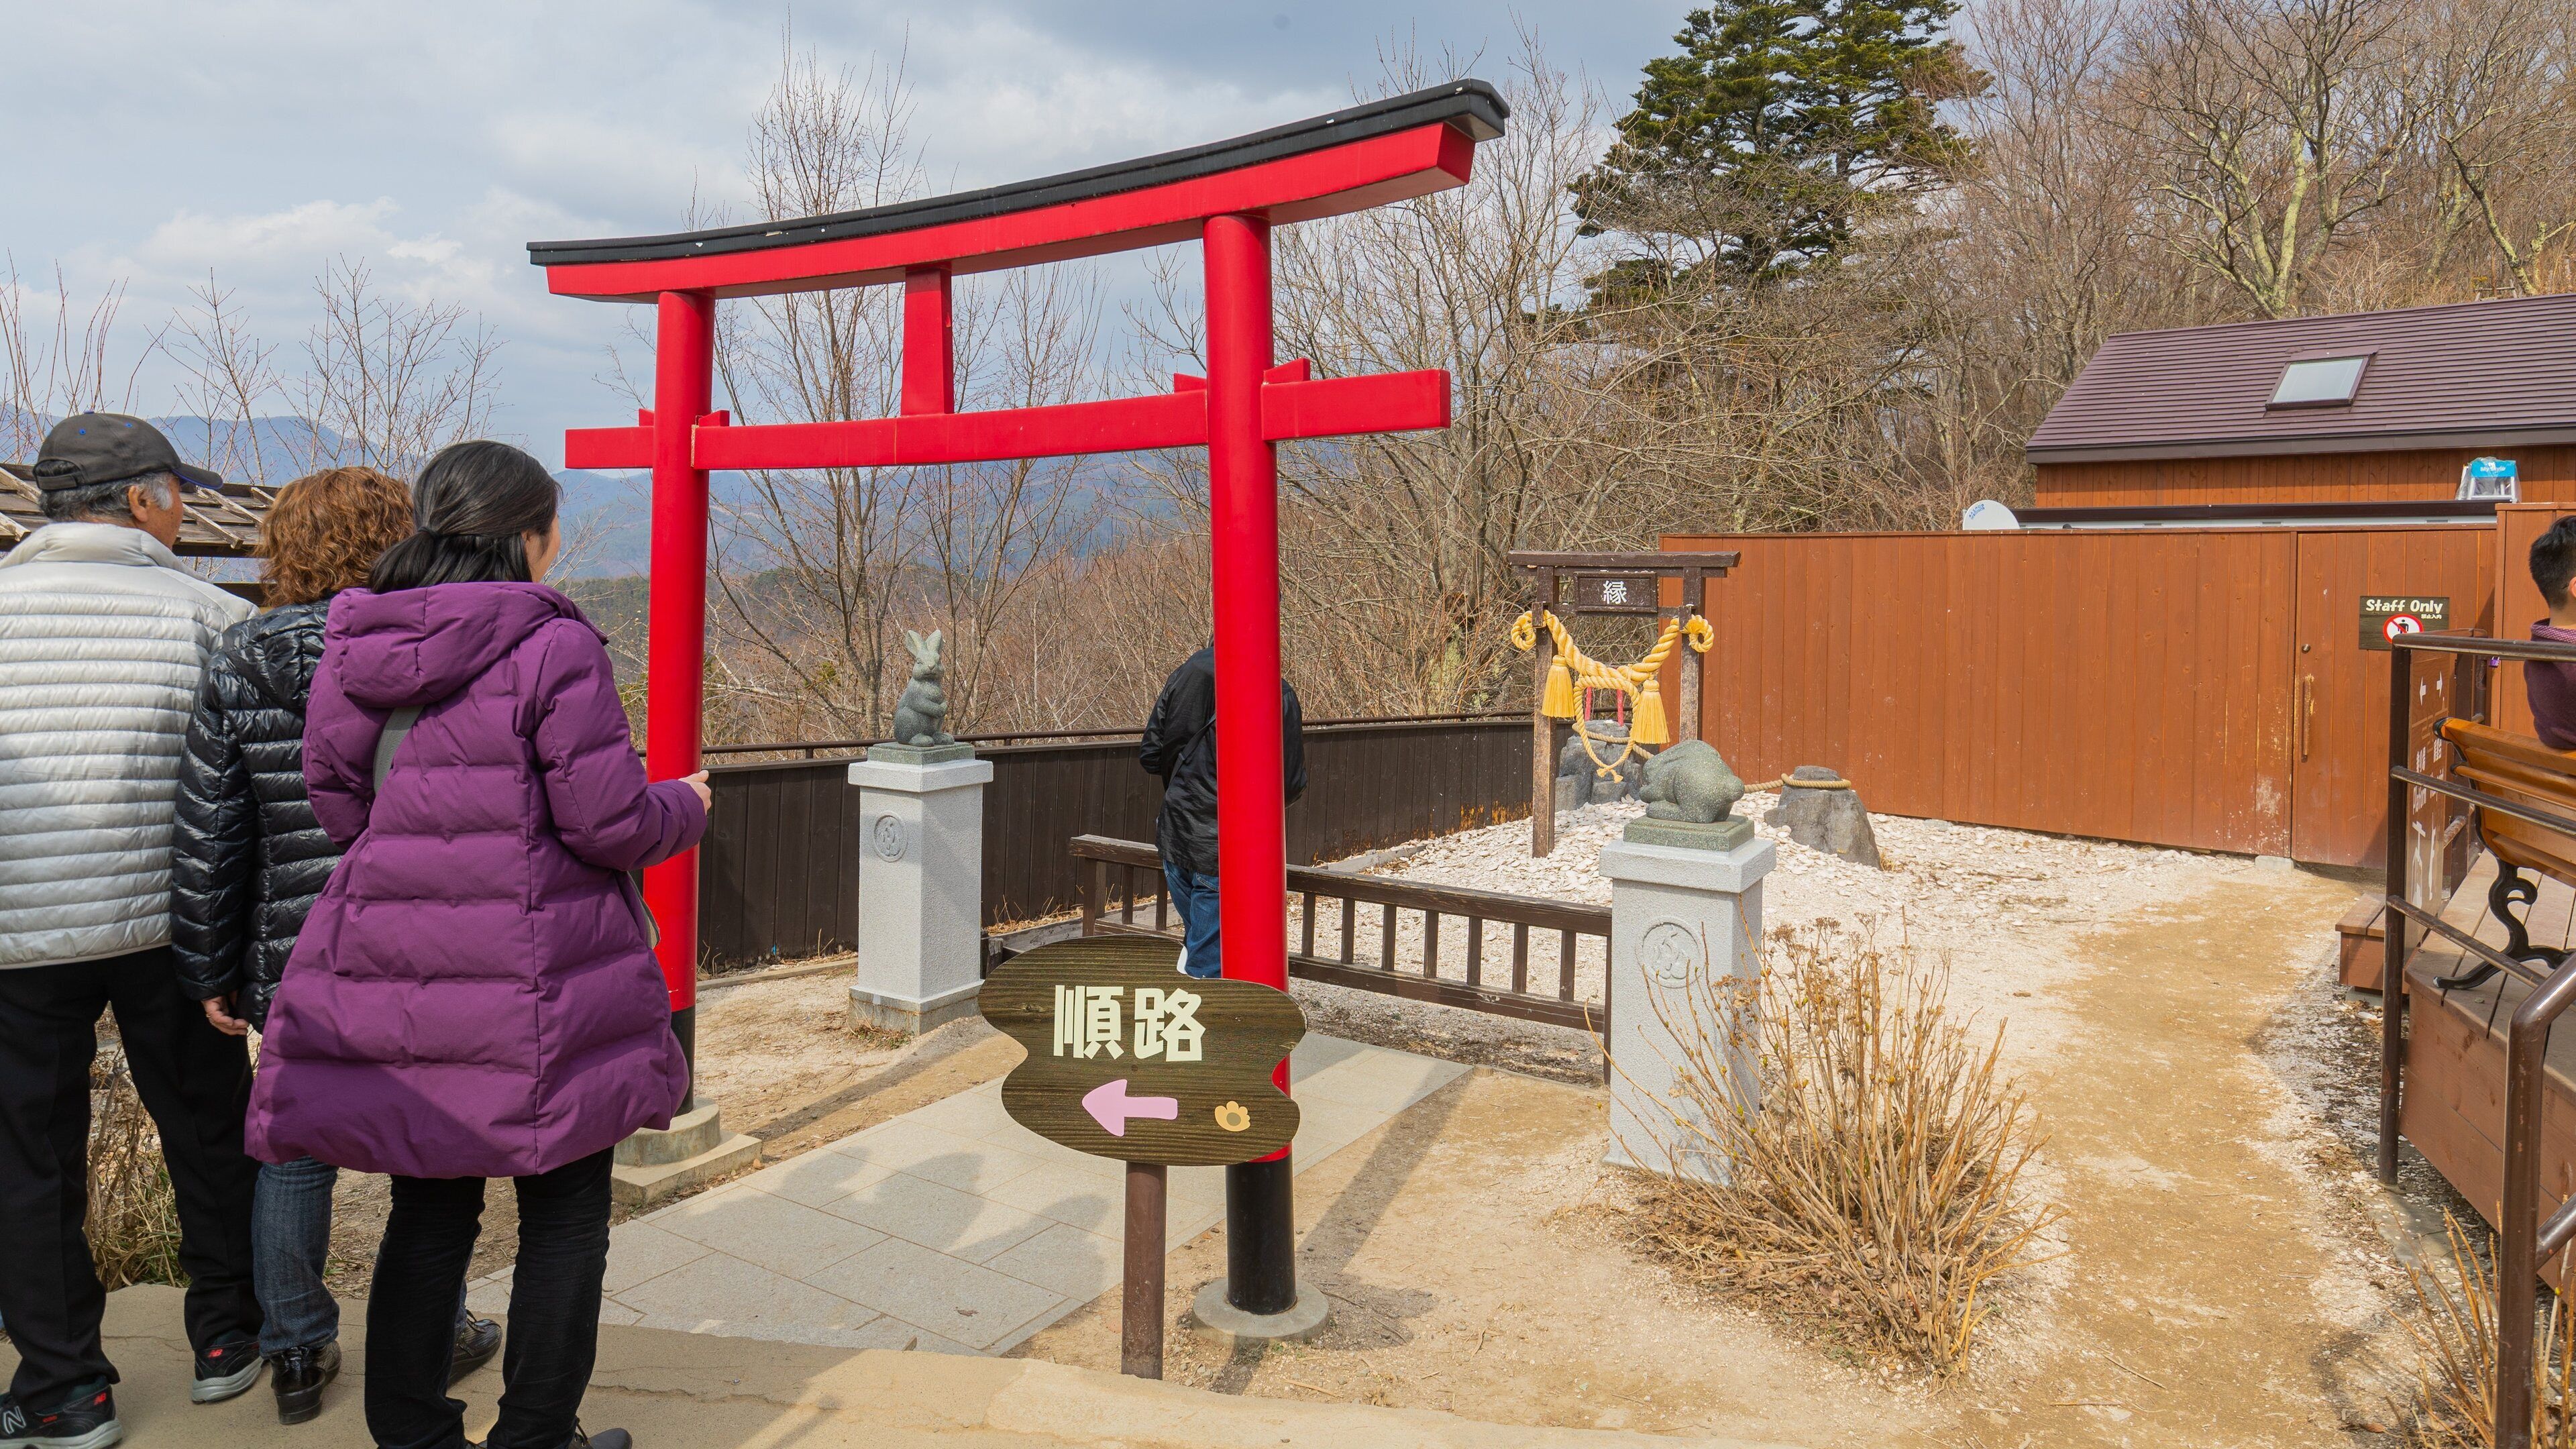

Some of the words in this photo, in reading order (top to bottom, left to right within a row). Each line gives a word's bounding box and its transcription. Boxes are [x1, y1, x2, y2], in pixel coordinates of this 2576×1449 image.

[1602, 580, 1627, 604] 縁
[2365, 599, 2406, 612] Staff
[2410, 600, 2443, 614] Only
[1053, 985, 1206, 1062] 順路
[3, 1405, 27, 1435] N
